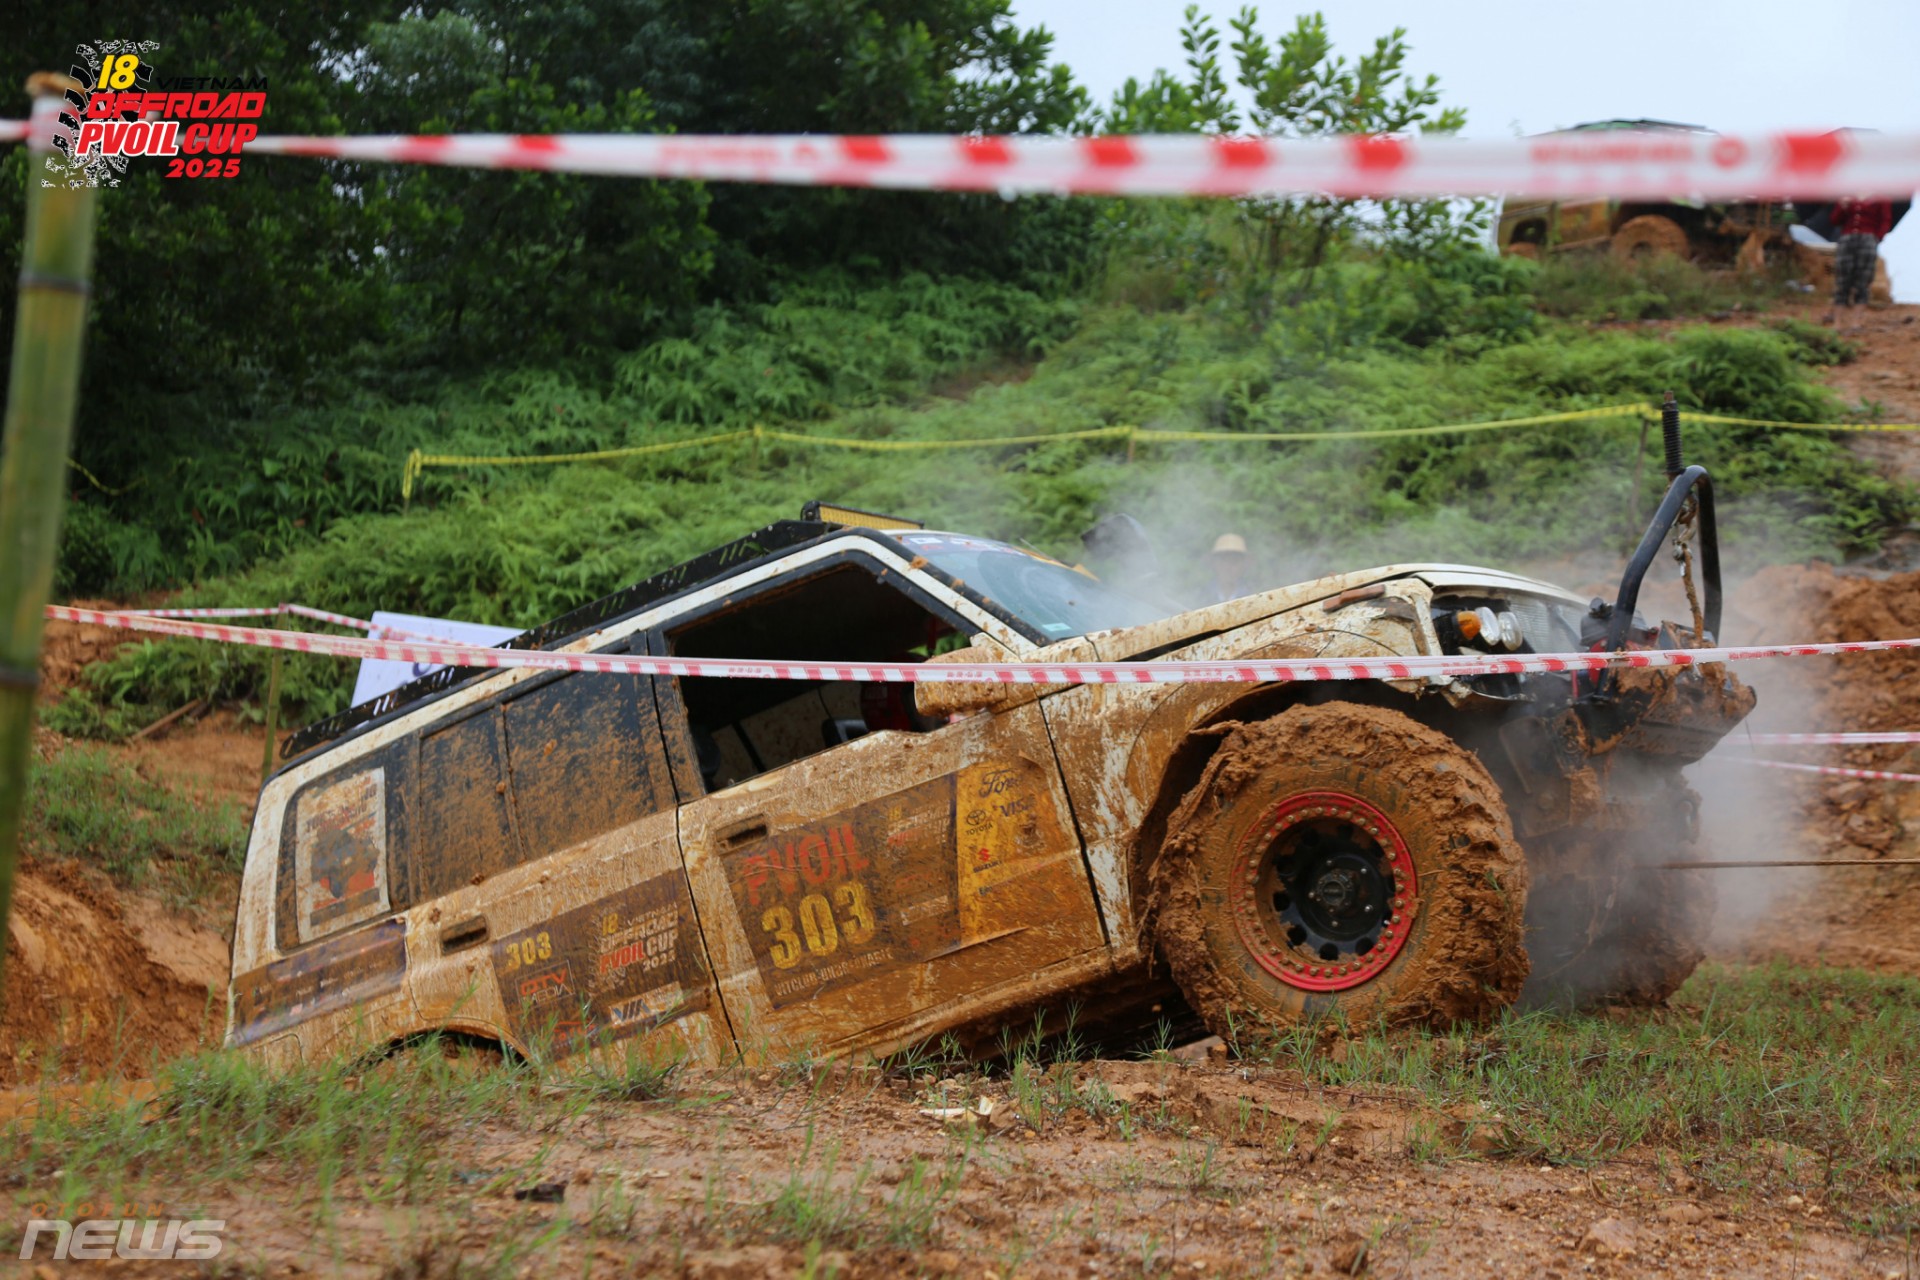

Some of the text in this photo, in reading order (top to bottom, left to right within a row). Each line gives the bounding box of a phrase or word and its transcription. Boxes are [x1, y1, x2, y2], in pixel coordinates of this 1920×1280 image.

[966, 822, 993, 836] TOYOTA
[742, 822, 869, 906] PVOIL
[602, 912, 618, 937] 18
[761, 881, 875, 970] 303
[506, 931, 552, 970] 303
[600, 927, 679, 976] PVOIL CUP
